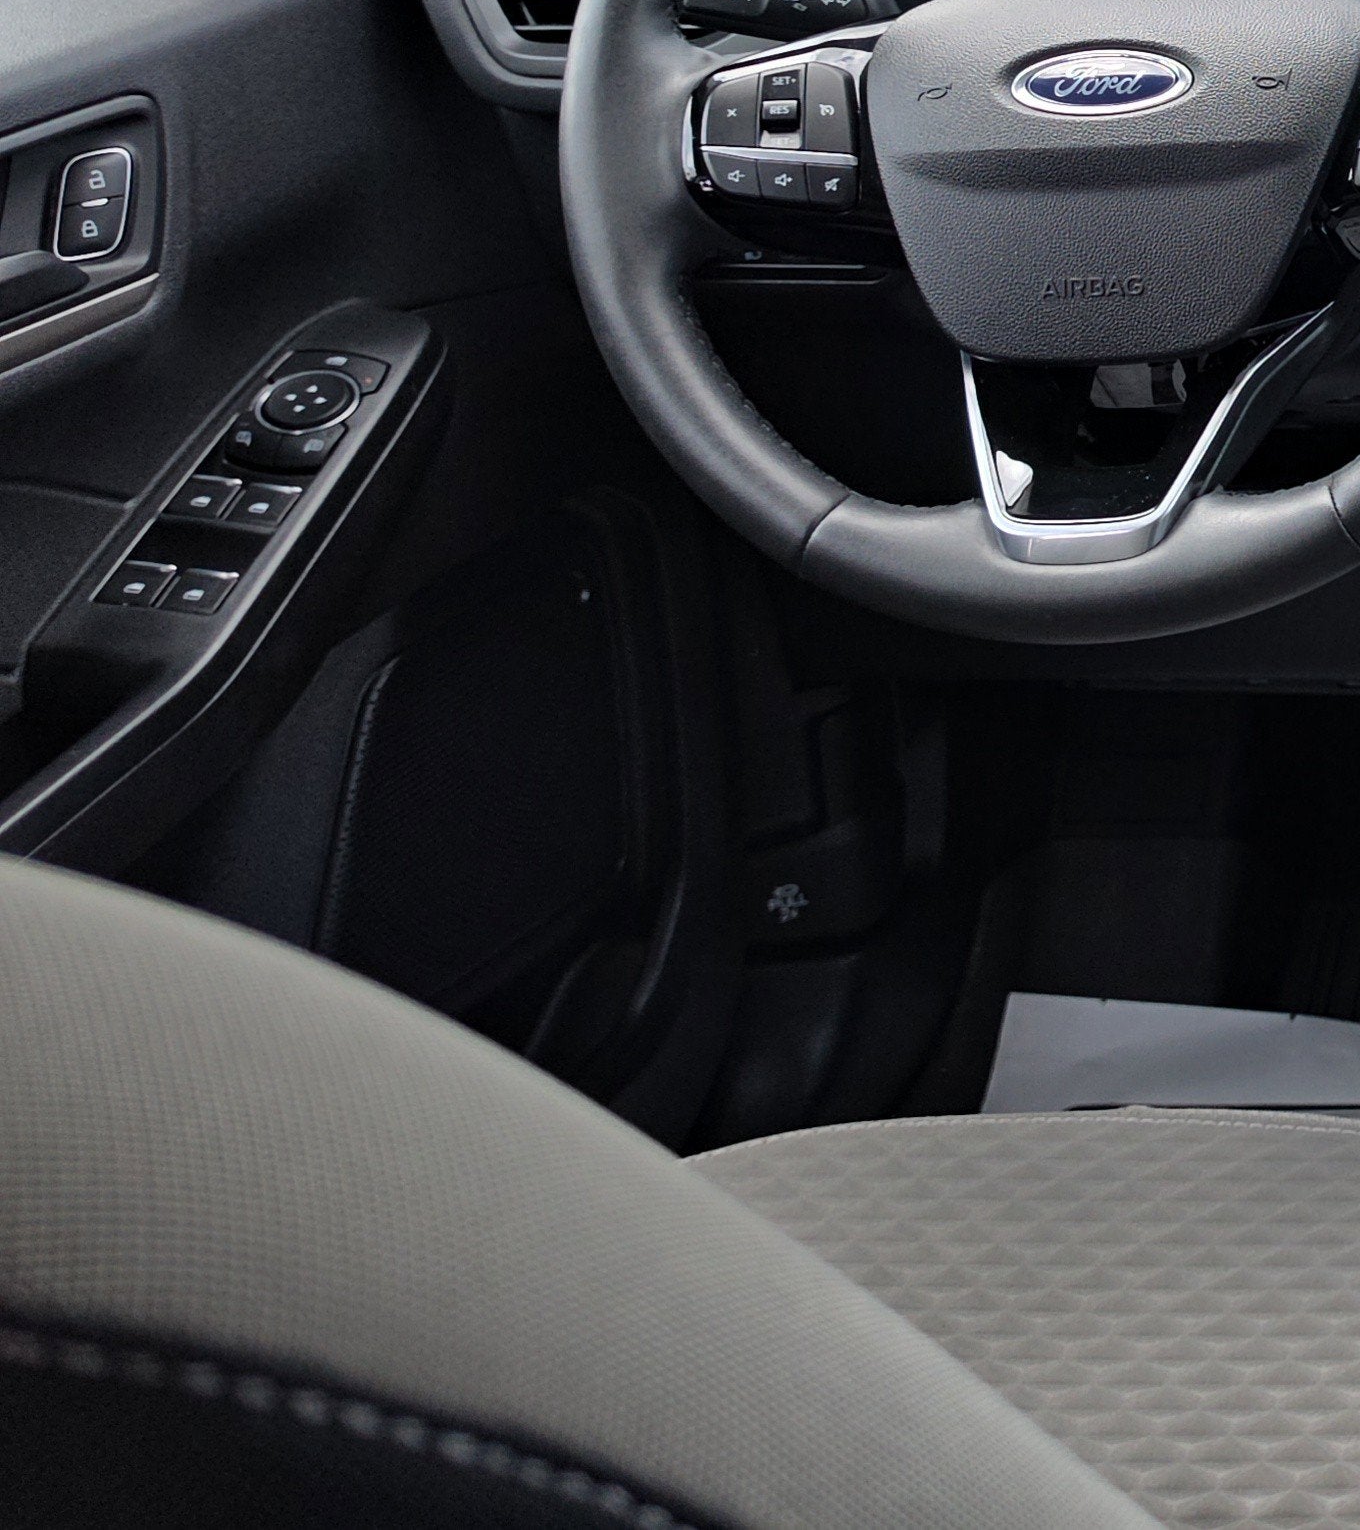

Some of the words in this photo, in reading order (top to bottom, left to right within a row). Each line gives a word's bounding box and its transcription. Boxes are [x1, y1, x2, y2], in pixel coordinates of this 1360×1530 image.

[1053, 65, 1143, 99] Ford
[769, 105, 790, 115] RES
[1041, 274, 1146, 300] AIRBAG
